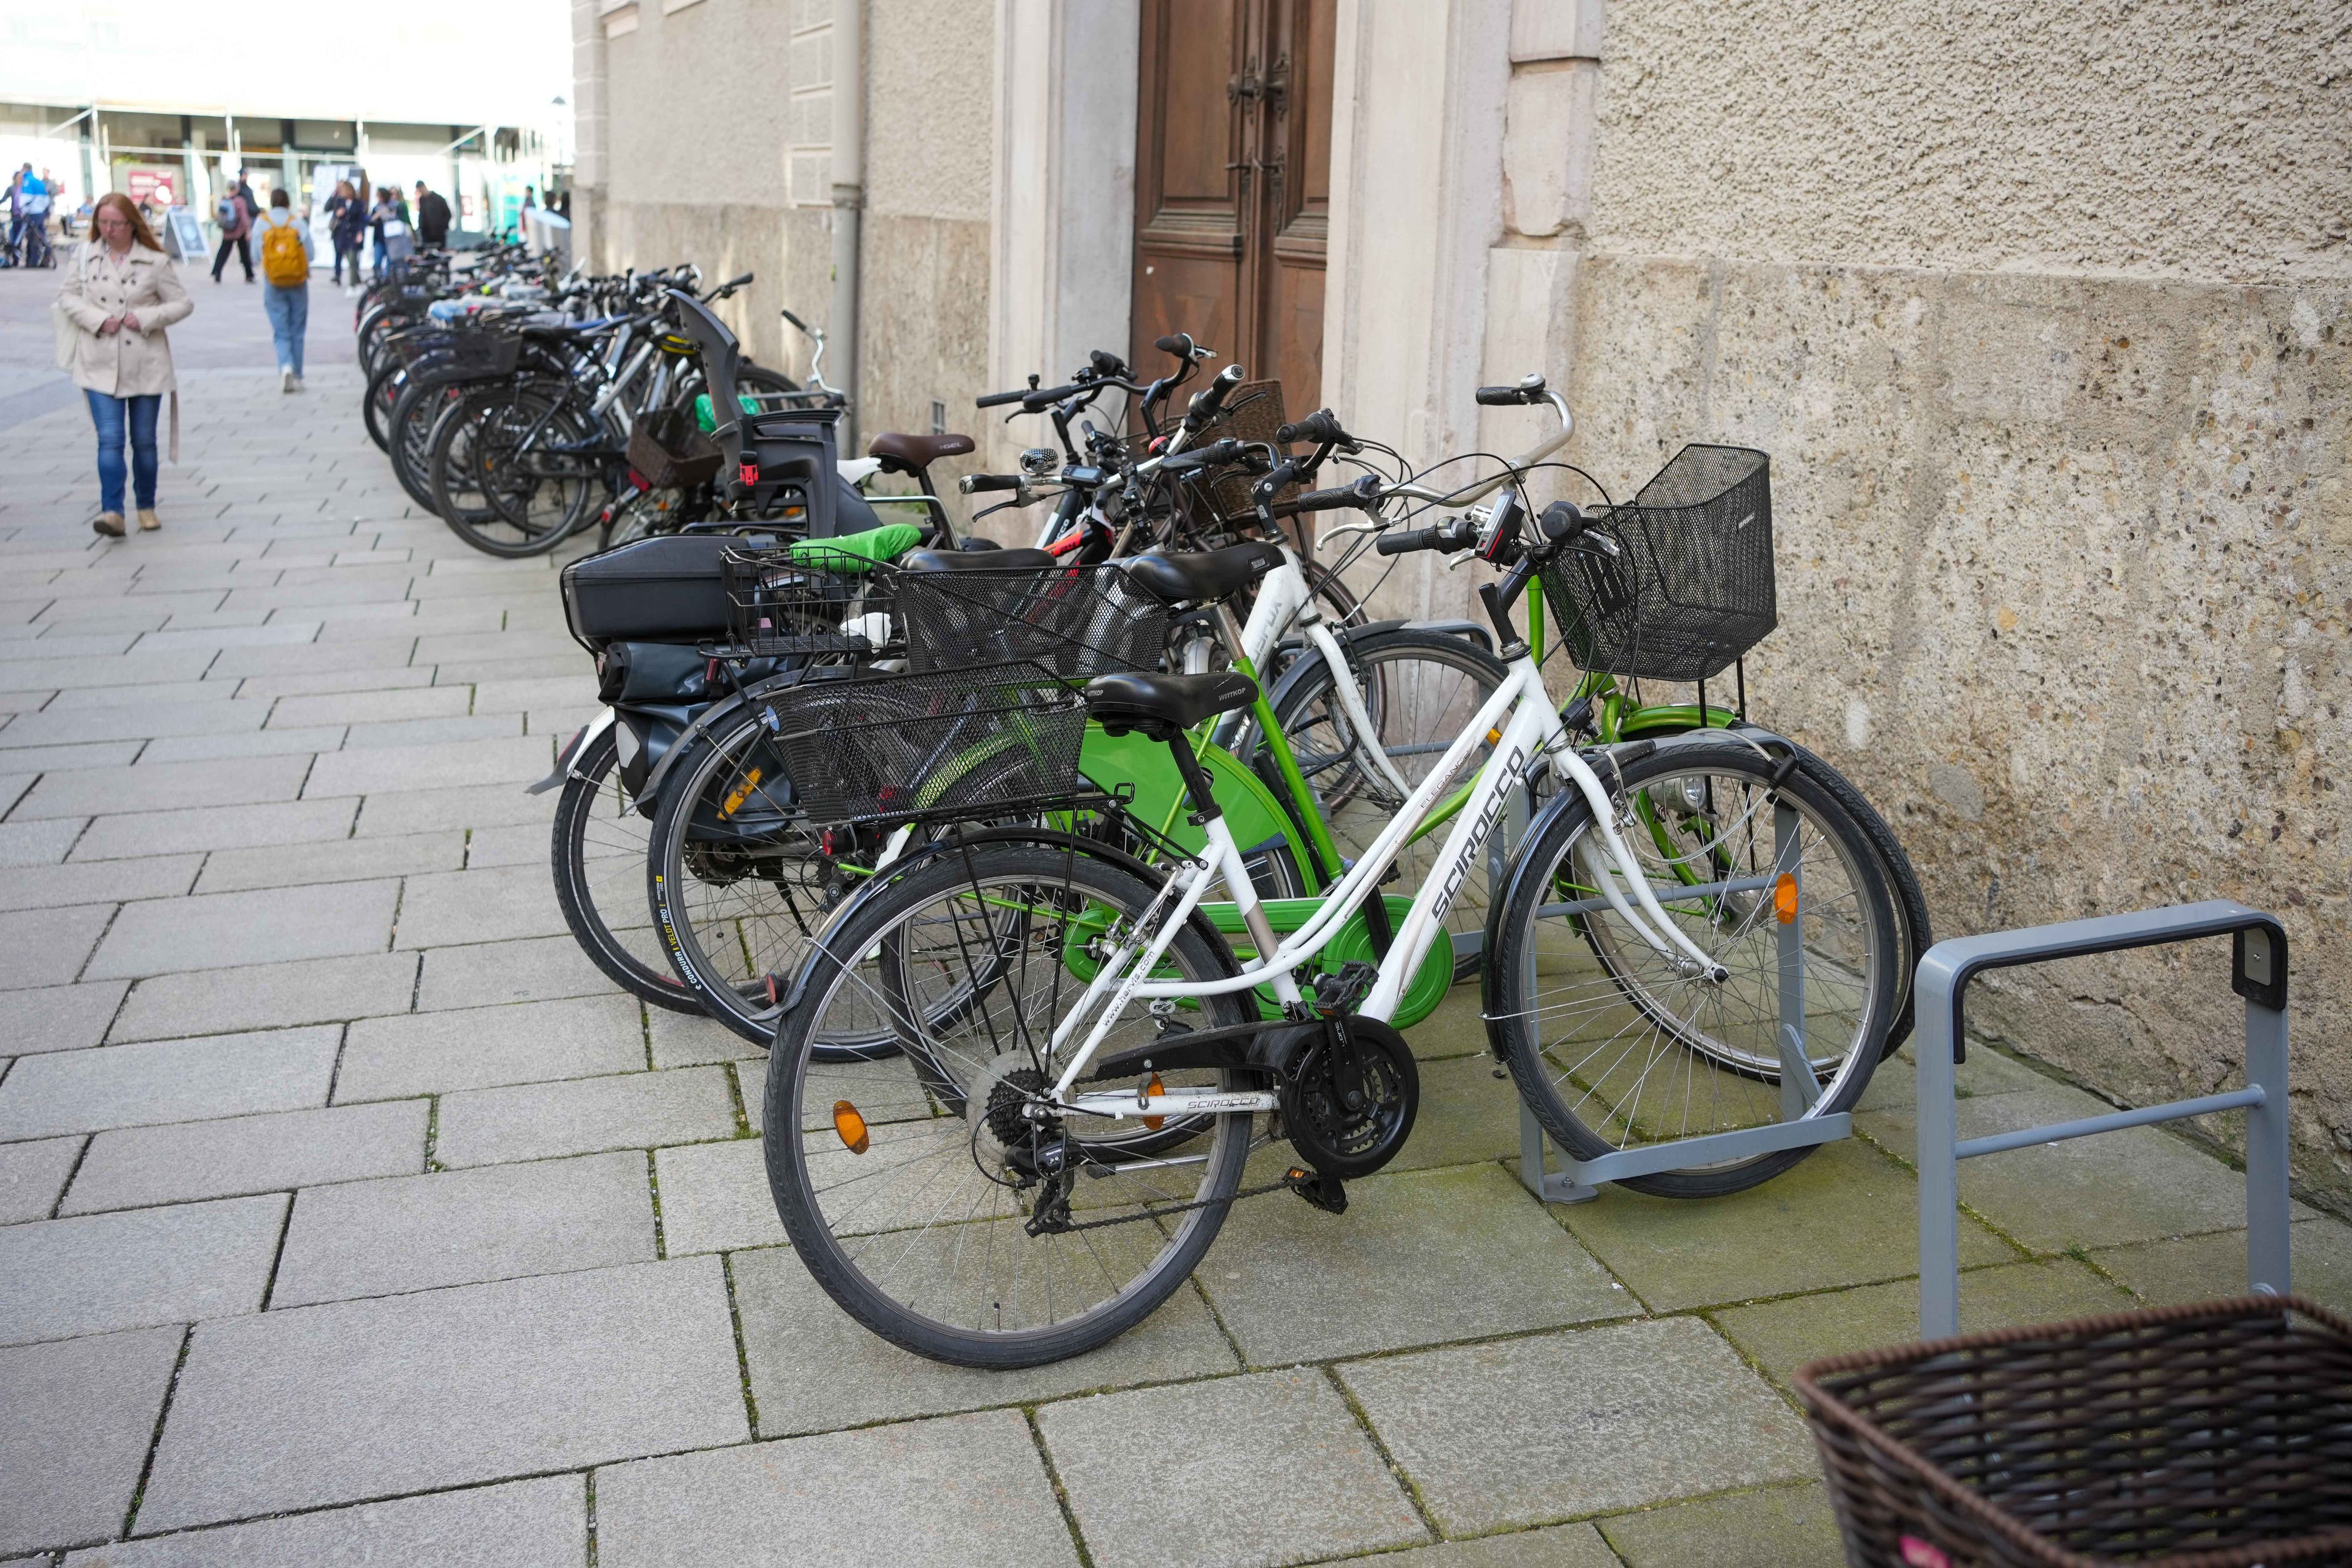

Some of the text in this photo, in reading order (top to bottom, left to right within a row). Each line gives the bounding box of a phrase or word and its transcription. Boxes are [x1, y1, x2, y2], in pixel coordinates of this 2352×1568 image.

[1739, 512, 1755, 529] BASIL
[1218, 687, 1246, 701] WITTKOP
[1420, 750, 1470, 809] ELEGANCE
[1431, 745, 1525, 924] SCIROCCO
[660, 908, 697, 984] CONDURA VELDT PRO
[1104, 951, 1155, 1026] www.hervis.com
[1188, 1096, 1260, 1109] SCIROCCO
